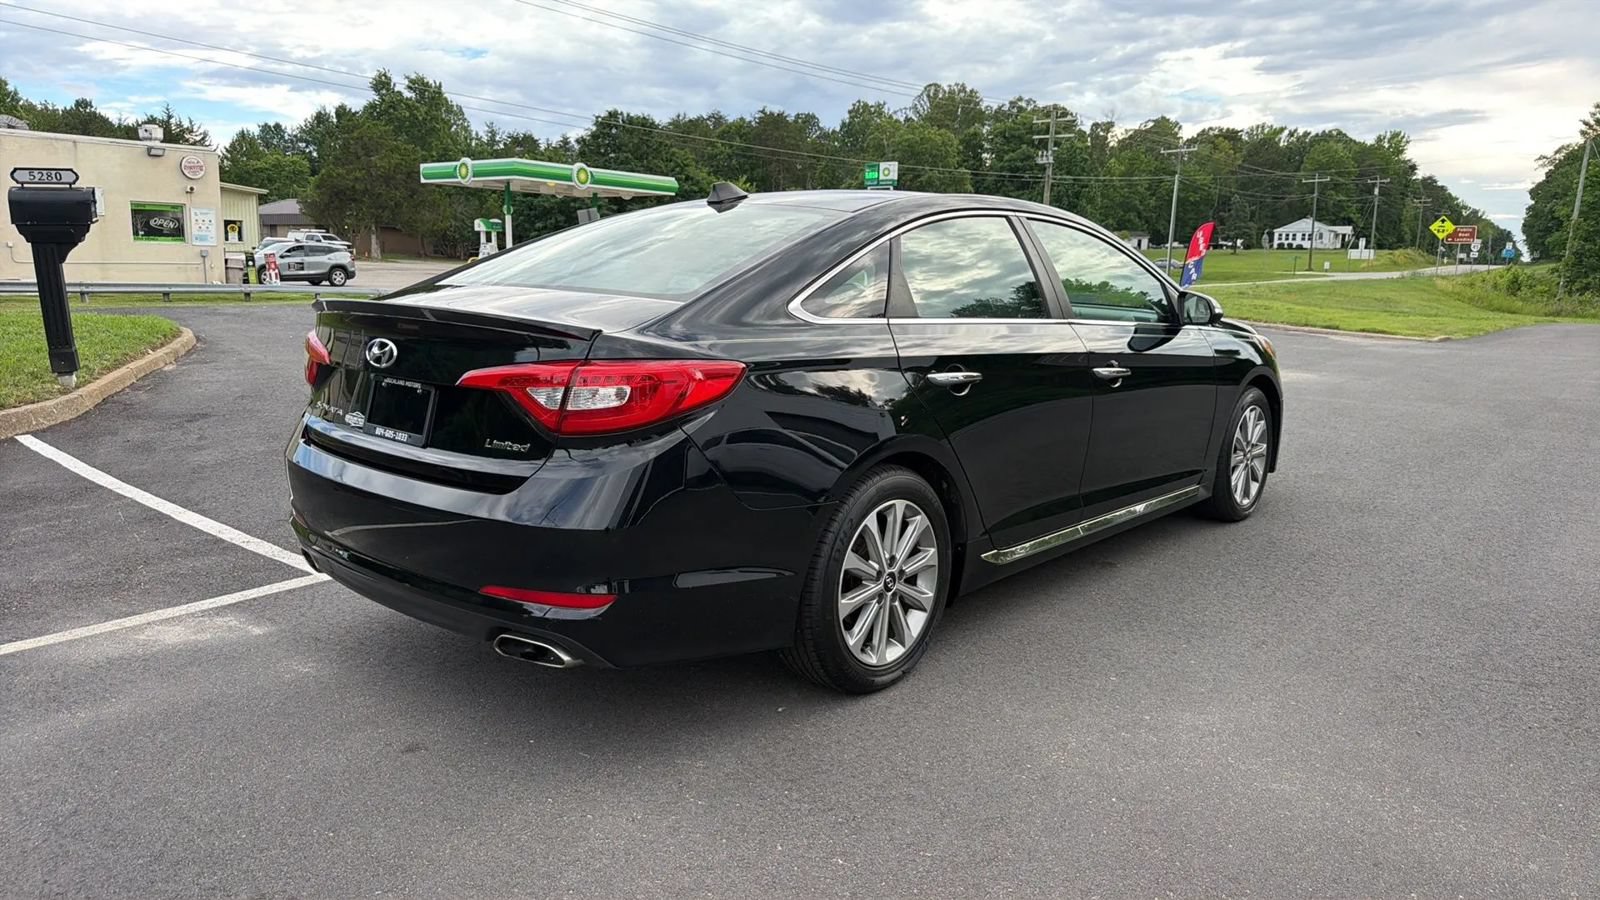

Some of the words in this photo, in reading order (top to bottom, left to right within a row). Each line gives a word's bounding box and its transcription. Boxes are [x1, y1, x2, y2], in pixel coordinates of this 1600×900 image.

[28, 171, 63, 182] 5280
[152, 217, 176, 229] OPEN
[1196, 230, 1207, 256] USED
[484, 438, 531, 453] Limited
